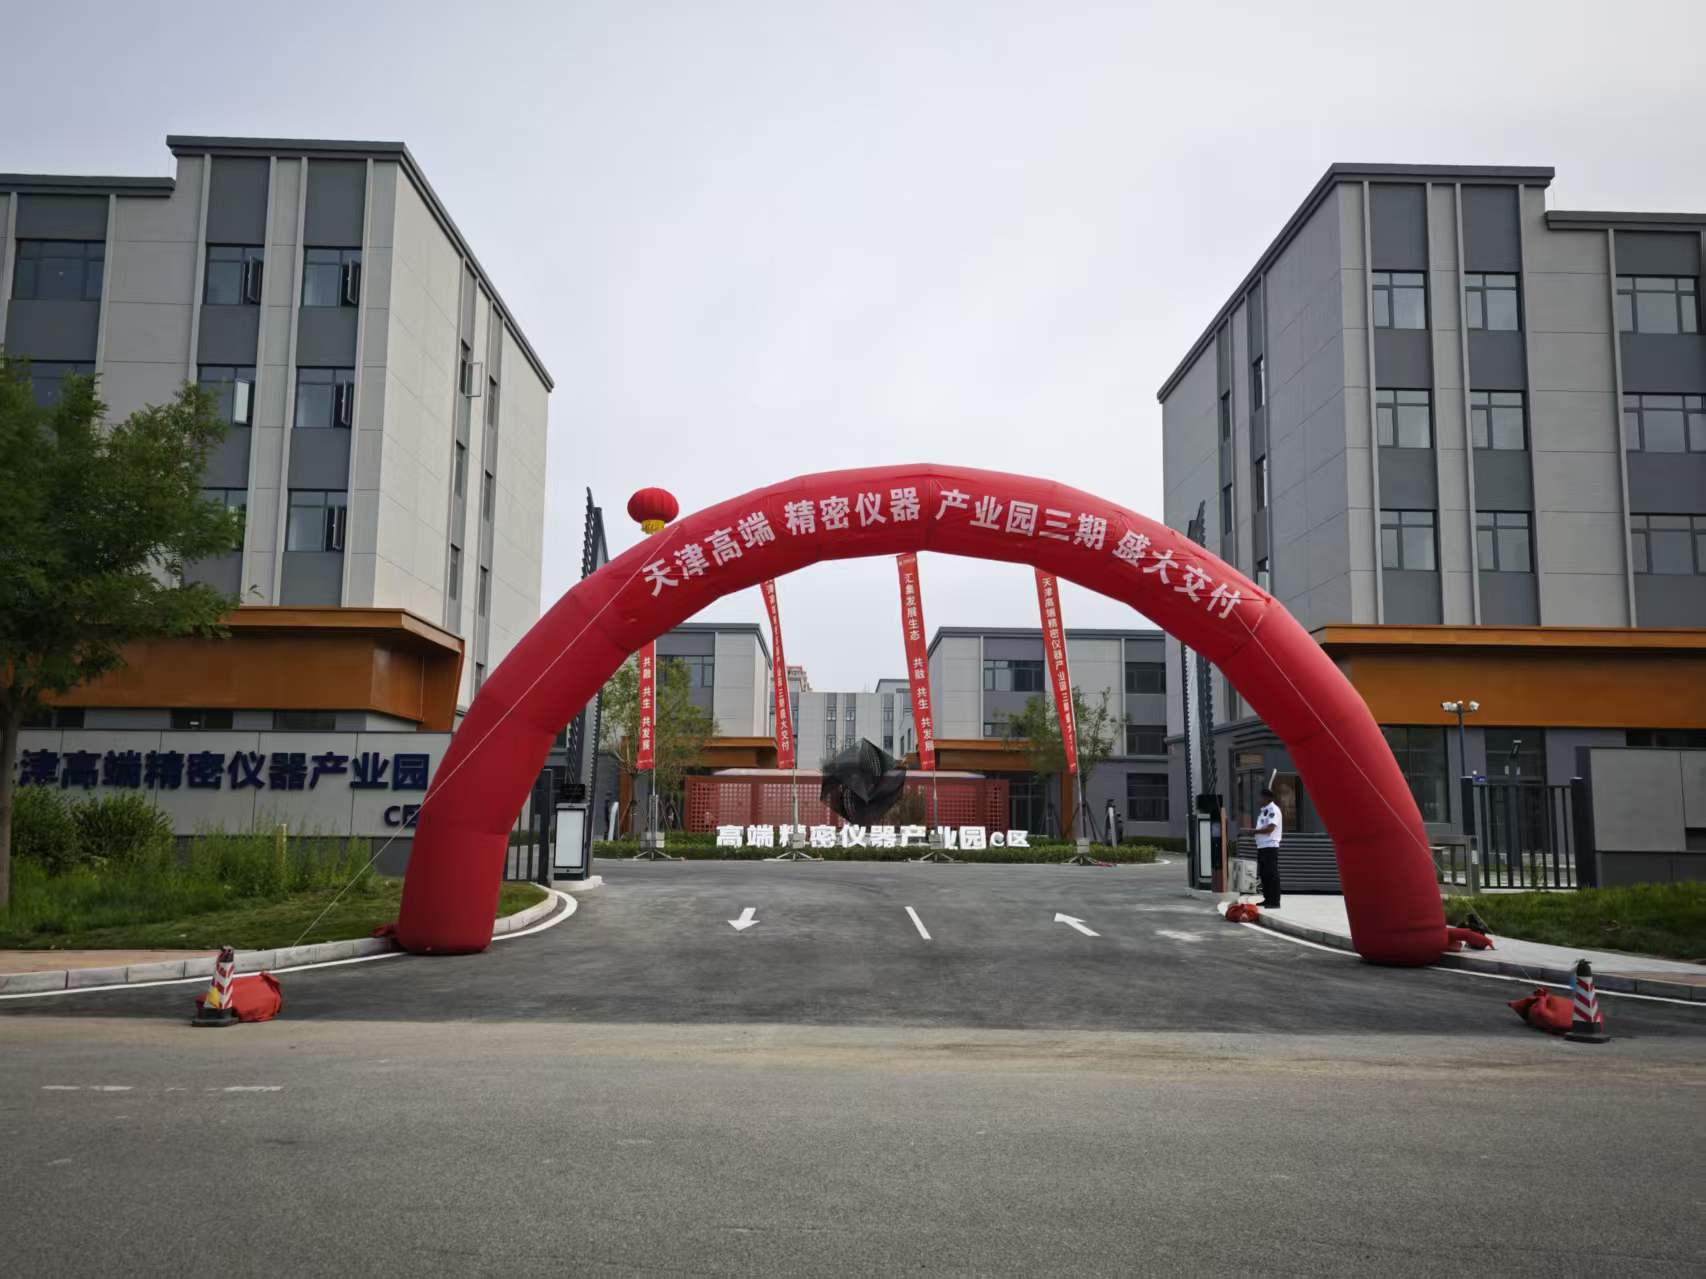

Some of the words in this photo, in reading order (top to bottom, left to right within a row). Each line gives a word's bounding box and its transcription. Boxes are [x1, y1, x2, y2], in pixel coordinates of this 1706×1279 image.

[642, 687, 651, 709] 共生
[917, 687, 929, 710] 共生
[13, 749, 430, 791] 津高端精密仪器产业园
